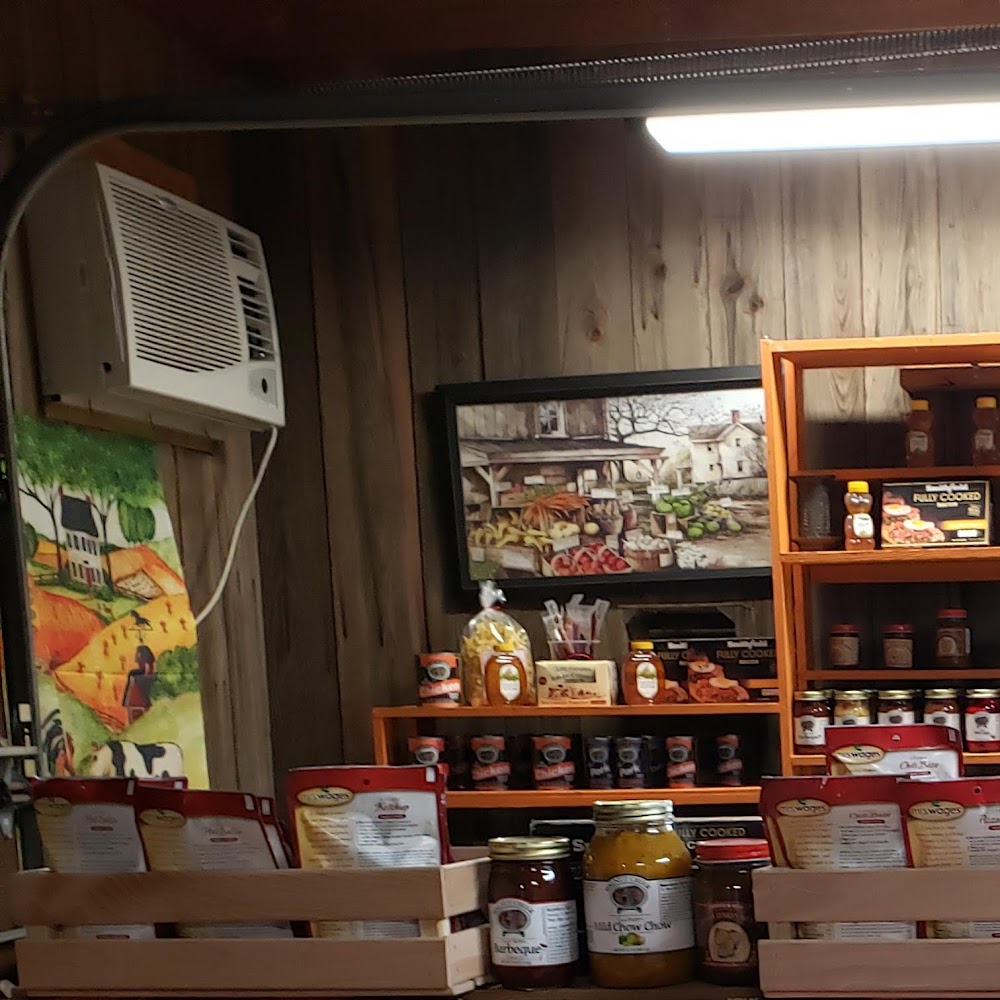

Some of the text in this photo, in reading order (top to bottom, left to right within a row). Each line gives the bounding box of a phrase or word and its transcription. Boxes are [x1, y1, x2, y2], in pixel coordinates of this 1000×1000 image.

[700, 827, 747, 838] COOKED
[613, 921, 641, 932] Chow
[644, 920, 672, 931] Chow
